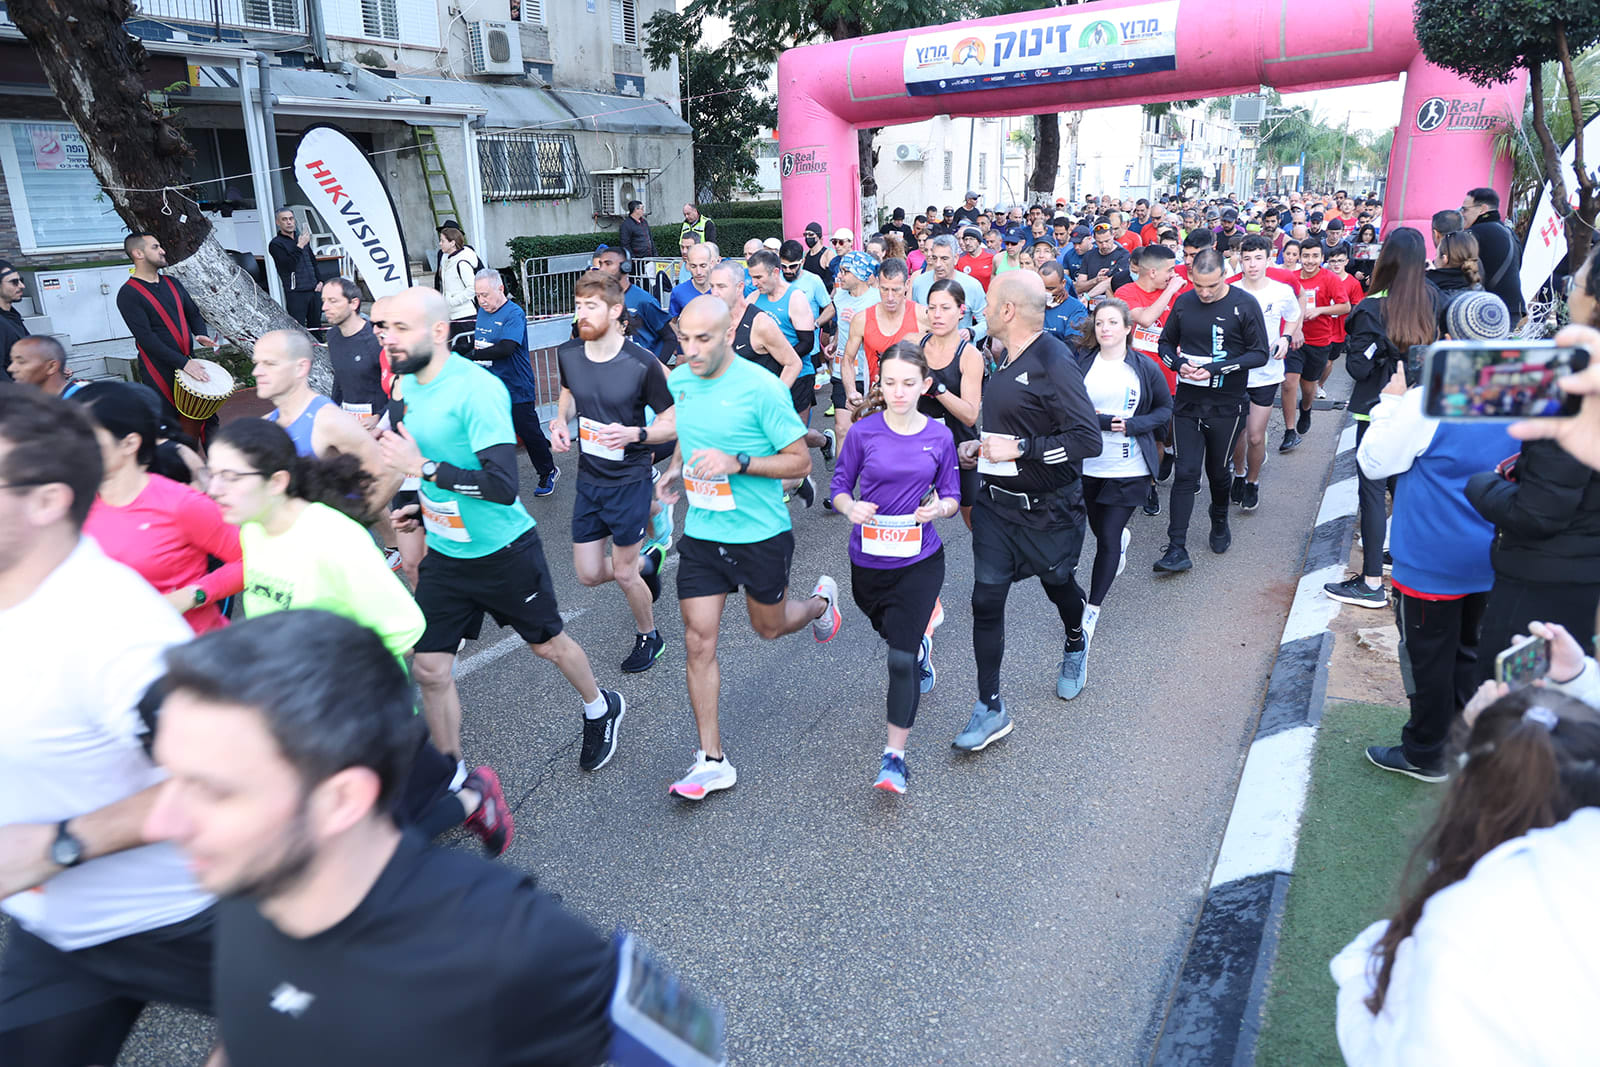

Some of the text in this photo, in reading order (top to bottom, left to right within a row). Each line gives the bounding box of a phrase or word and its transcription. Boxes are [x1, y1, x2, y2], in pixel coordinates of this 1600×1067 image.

[1120, 19, 1158, 39] מרוץ
[916, 45, 947, 63] מרוץ
[994, 24, 1072, 67] זינוק
[1450, 97, 1486, 113] Real
[65, 144, 84, 153] הפה
[795, 150, 815, 161] Real
[794, 161, 827, 172] Timing
[305, 159, 400, 282] HIKVISION
[875, 528, 909, 541] 1607
[603, 718, 612, 743] HOKA
